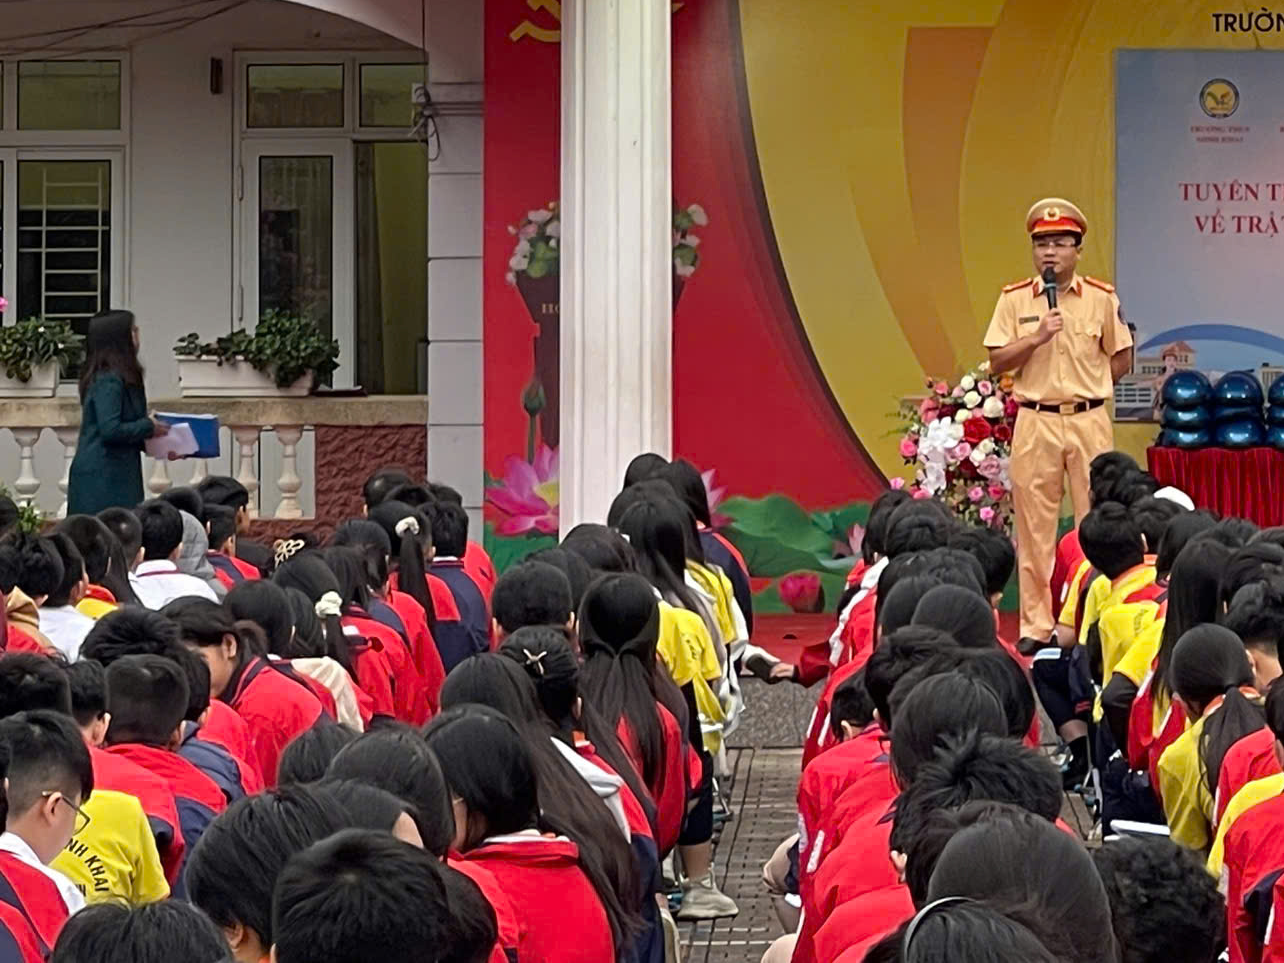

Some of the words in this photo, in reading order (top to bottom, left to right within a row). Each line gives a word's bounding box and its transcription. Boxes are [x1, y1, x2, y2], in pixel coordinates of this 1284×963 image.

[1178, 178, 1260, 203] TUYÊN
[1194, 207, 1226, 235] VỀ
[85, 855, 110, 892] KHAI
